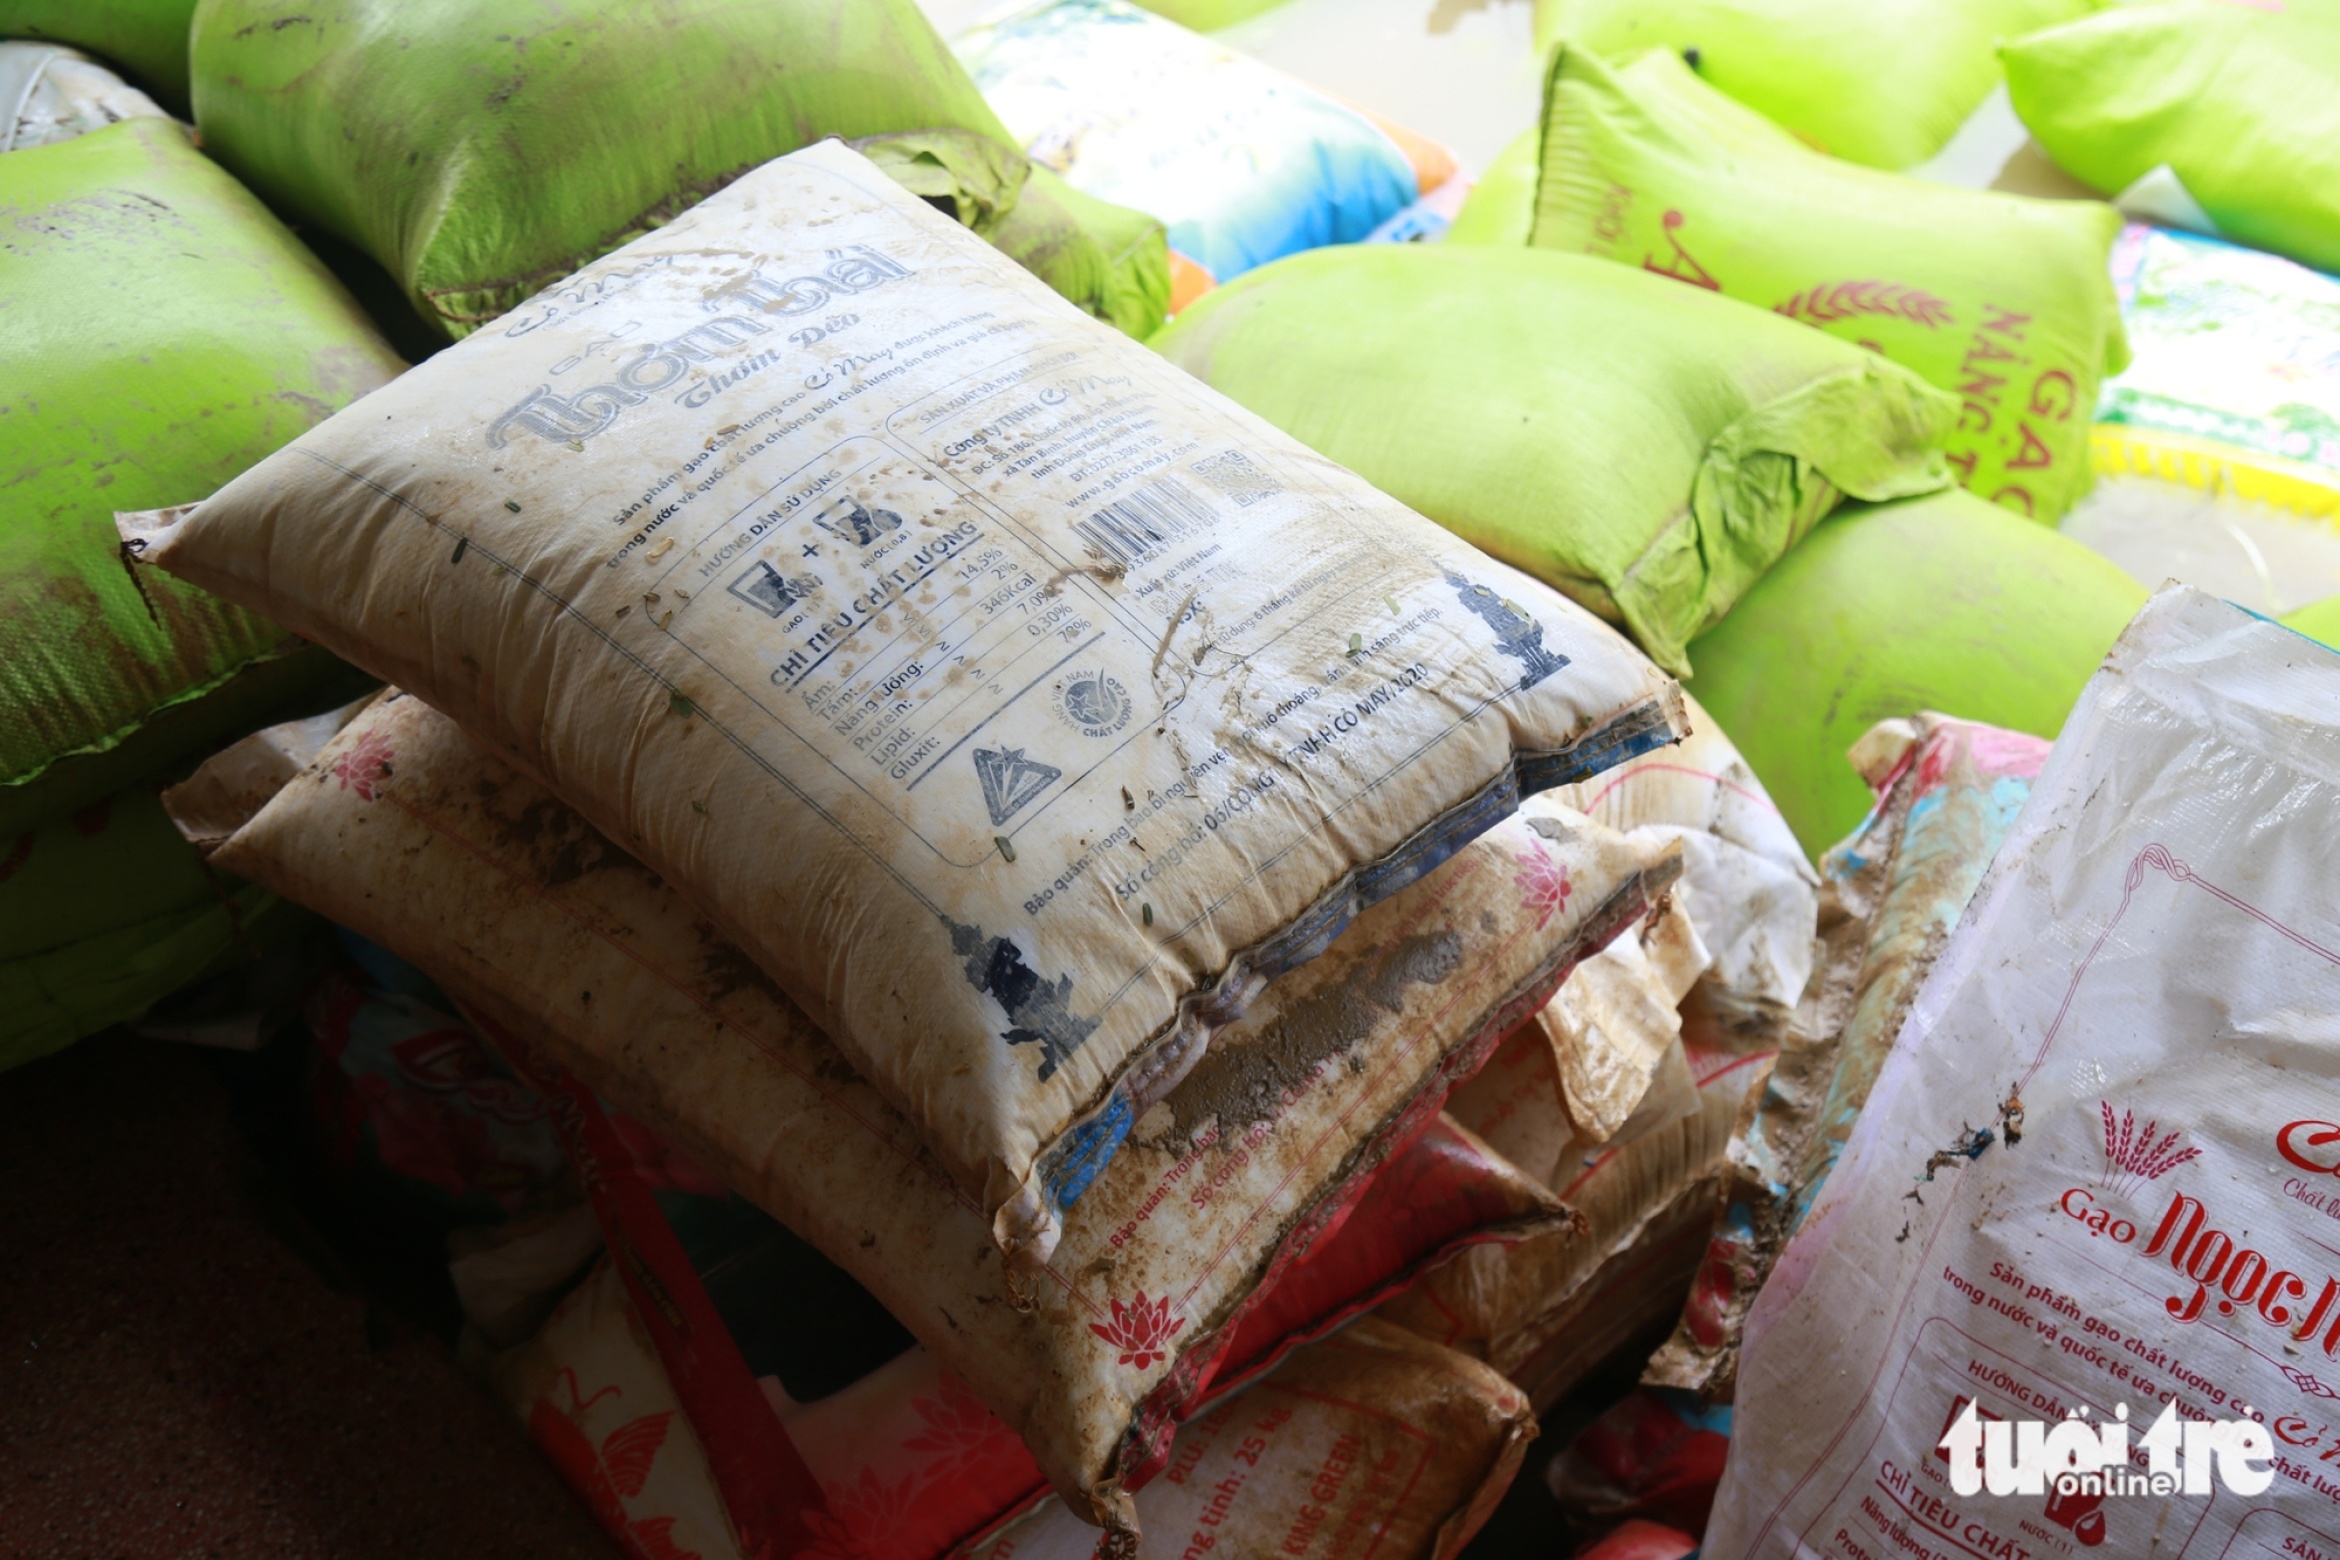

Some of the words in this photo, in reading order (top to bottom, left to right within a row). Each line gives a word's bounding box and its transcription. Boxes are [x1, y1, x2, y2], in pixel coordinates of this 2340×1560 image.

[605, 533, 647, 570] trong
[644, 502, 680, 534] nước
[678, 492, 697, 506] và
[697, 468, 731, 493] quốc
[746, 442, 765, 457] ưa
[764, 413, 816, 445] chuộng
[812, 399, 839, 417] bởi
[838, 384, 869, 402] chất
[868, 365, 906, 387] lượng
[922, 344, 952, 360] định
[952, 337, 967, 349] và
[967, 331, 987, 345] giá
[612, 502, 643, 526] Sản
[642, 471, 684, 504] phẩm
[682, 451, 710, 474] gạo
[741, 407, 783, 432] lượng
[782, 392, 806, 408] cao
[943, 433, 988, 458] Công
[983, 423, 1003, 440] ty
[995, 402, 1042, 430] TNHH
[971, 460, 995, 476] ĐC:
[1002, 465, 1019, 478] xã
[1031, 465, 1056, 480] tỉnh
[698, 532, 753, 577] HƯỚNG
[749, 510, 783, 536] DẪN
[779, 495, 802, 514] SỬ
[798, 468, 843, 500] DỤNG
[860, 546, 888, 571] NƯỚC
[1135, 578, 1161, 600] Xuất
[1177, 554, 1201, 572] Việt
[1197, 543, 1223, 560] Nam
[770, 648, 810, 688] CHỈ
[808, 612, 854, 652] TIÊU
[852, 569, 908, 615] CHẤT
[900, 519, 981, 585] LƯỢNG
[782, 614, 805, 635] GẠO
[803, 682, 836, 712] Ẩm:
[959, 549, 1004, 580] 14,5%
[1230, 616, 1256, 636] dụng:
[1253, 611, 1263, 620] 6
[1261, 594, 1290, 617] tháng
[815, 687, 859, 724] Tấm:
[990, 561, 1019, 582] 2%
[834, 699, 880, 737] Năng
[979, 572, 1038, 616] 346Kcal
[870, 726, 917, 767] Lipid:
[1026, 602, 1073, 637] 0,30%
[1066, 670, 1095, 683] NAM
[1107, 677, 1127, 696] CAO
[852, 699, 914, 752] Protein:
[1083, 727, 1113, 738] CHẤT
[1112, 698, 1132, 731] LƯỢNG
[890, 735, 941, 781] Gluxit:
[1023, 889, 1055, 916] Bảo
[1053, 853, 1094, 891] quản:
[1088, 826, 1131, 858] Trong
[1123, 807, 1152, 831] bao
[1150, 795, 1167, 811] bì
[1370, 633, 1401, 654] sáng
[1397, 620, 1420, 638] trực
[1414, 606, 1443, 627] tiếp.
[1115, 872, 1140, 901] Số
[1140, 846, 1183, 884] công
[1334, 708, 1359, 733] CỎ
[1355, 662, 1429, 718] MAY/2020
[1109, 1220, 1137, 1248] Bảo
[1136, 1181, 1172, 1222] quản:
[1164, 1148, 1203, 1185] Trong
[1191, 1182, 1214, 1210] Số
[1211, 1148, 1250, 1188] công
[2283, 1177, 2324, 1210] Chất
[2061, 1188, 2137, 1244] Gạo
[2138, 1190, 2307, 1324] Ngọc
[1989, 1262, 2025, 1291] Sản
[2026, 1284, 2082, 1322] phẩm
[2083, 1314, 2121, 1343] gạo
[2123, 1334, 2168, 1369] chất
[2170, 1359, 2228, 1406] lượng
[1942, 1266, 1987, 1305] trong
[1987, 1296, 2034, 1329] nước
[2035, 1319, 2059, 1341] và
[2059, 1334, 2108, 1370] quốc
[2108, 1358, 2134, 1380] tế
[2131, 1375, 2156, 1395] ưa
[2267, 1456, 2310, 1484] chất
[1967, 1359, 2032, 1401] HƯỚNG
[1165, 1438, 1208, 1486] PLU:
[1199, 1470, 1248, 1527] tịnh:
[1233, 1436, 1268, 1467] 25
[1254, 1405, 1294, 1433] kg
[1920, 1462, 1943, 1483] GẠO
[1281, 1504, 1328, 1556] KING
[1309, 1433, 1363, 1504] GREEN
[1879, 1459, 1910, 1495] CHỈ
[1912, 1487, 1961, 1529] TIÊU
[1962, 1521, 2033, 1560] CHẤT
[1860, 1495, 1894, 1534] Năng
[1889, 1523, 1932, 1560] lượng
[2018, 1519, 2055, 1545] NƯỚC
